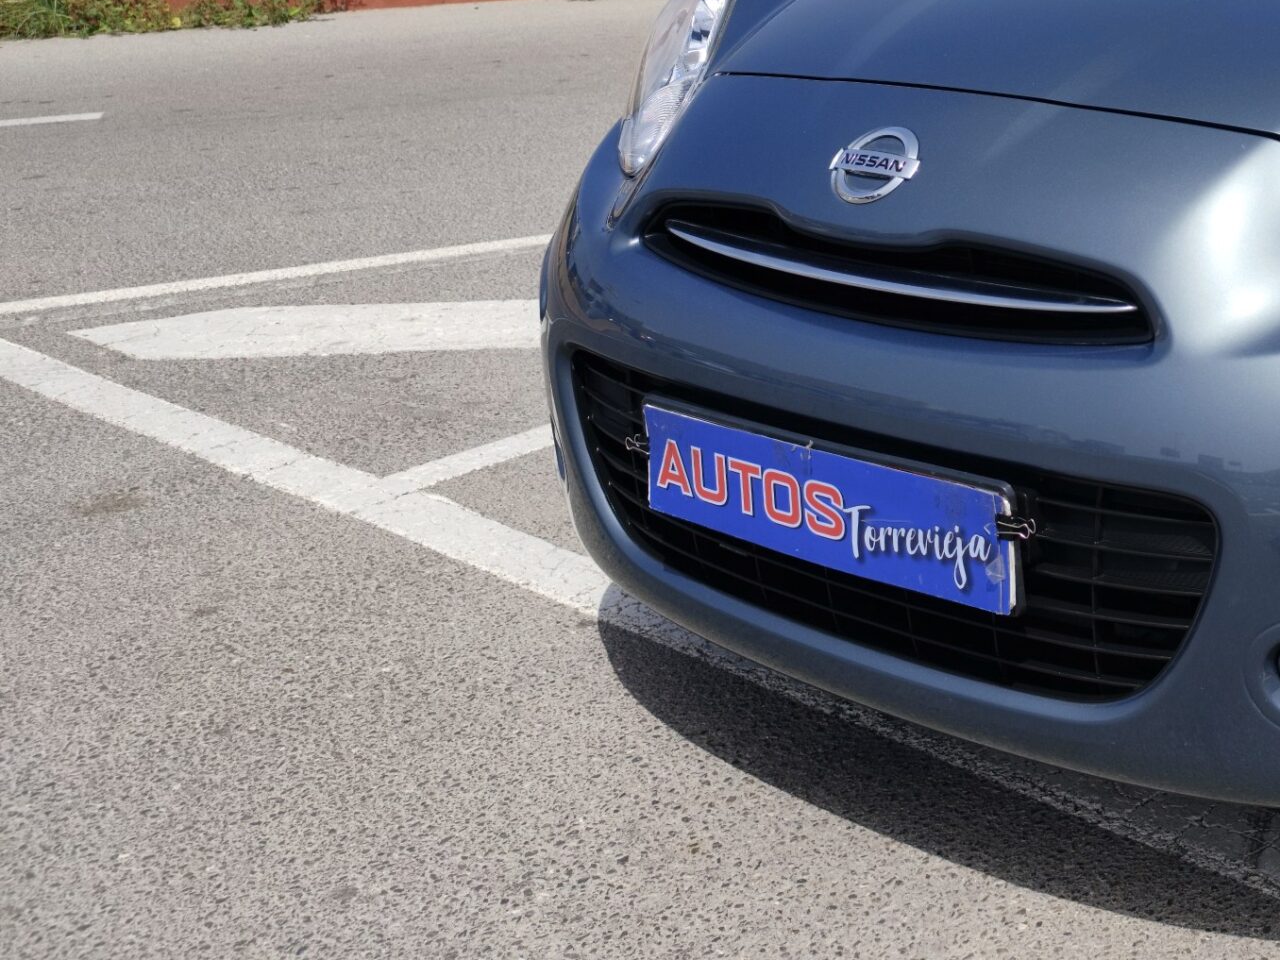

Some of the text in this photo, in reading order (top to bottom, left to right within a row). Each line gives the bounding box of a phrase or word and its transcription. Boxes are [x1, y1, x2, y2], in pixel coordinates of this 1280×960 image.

[841, 152, 907, 173] NISSAN
[656, 438, 993, 590] AUTOS Torrevieja
